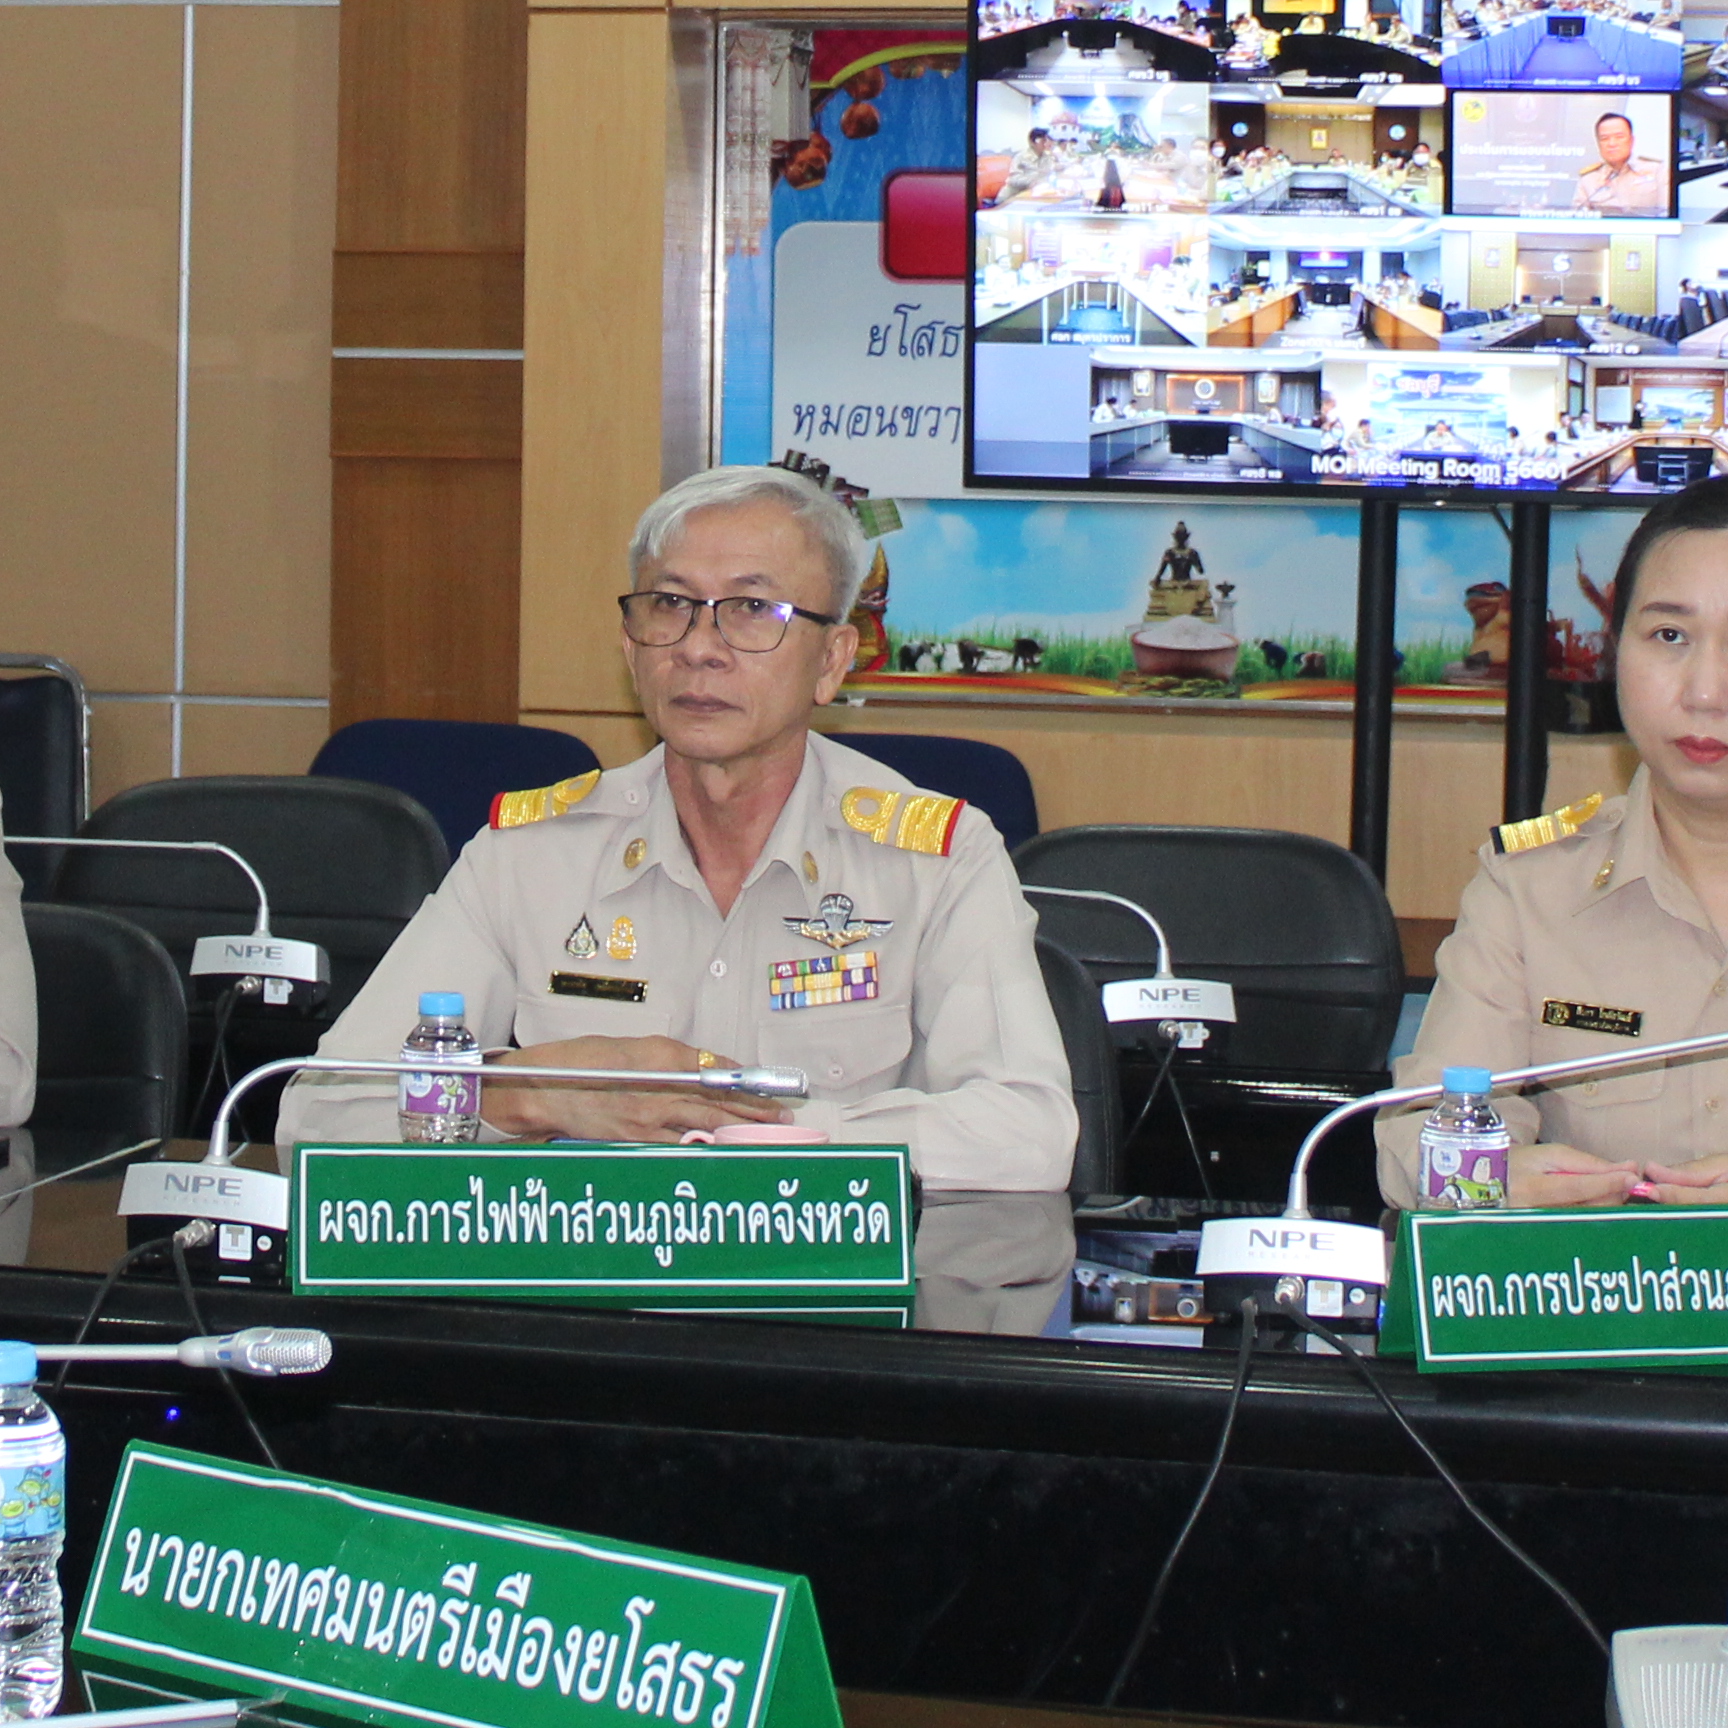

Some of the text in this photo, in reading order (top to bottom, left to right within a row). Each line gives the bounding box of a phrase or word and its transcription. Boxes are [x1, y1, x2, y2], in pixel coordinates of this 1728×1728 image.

[1311, 454, 1350, 475] MOI
[1358, 456, 1439, 479] Meeting
[1443, 459, 1501, 478] Room
[224, 944, 283, 960] NPE
[1139, 988, 1201, 1002] NPE
[164, 1173, 243, 1197] NPE
[318, 1175, 892, 1267] ผจก.การไฟฟ้าส่วนภูมิภาคจังหวัด
[1248, 1228, 1335, 1251] NPE
[119, 1526, 745, 1728] นายกเทศมนตรีเมืองยโสธร
